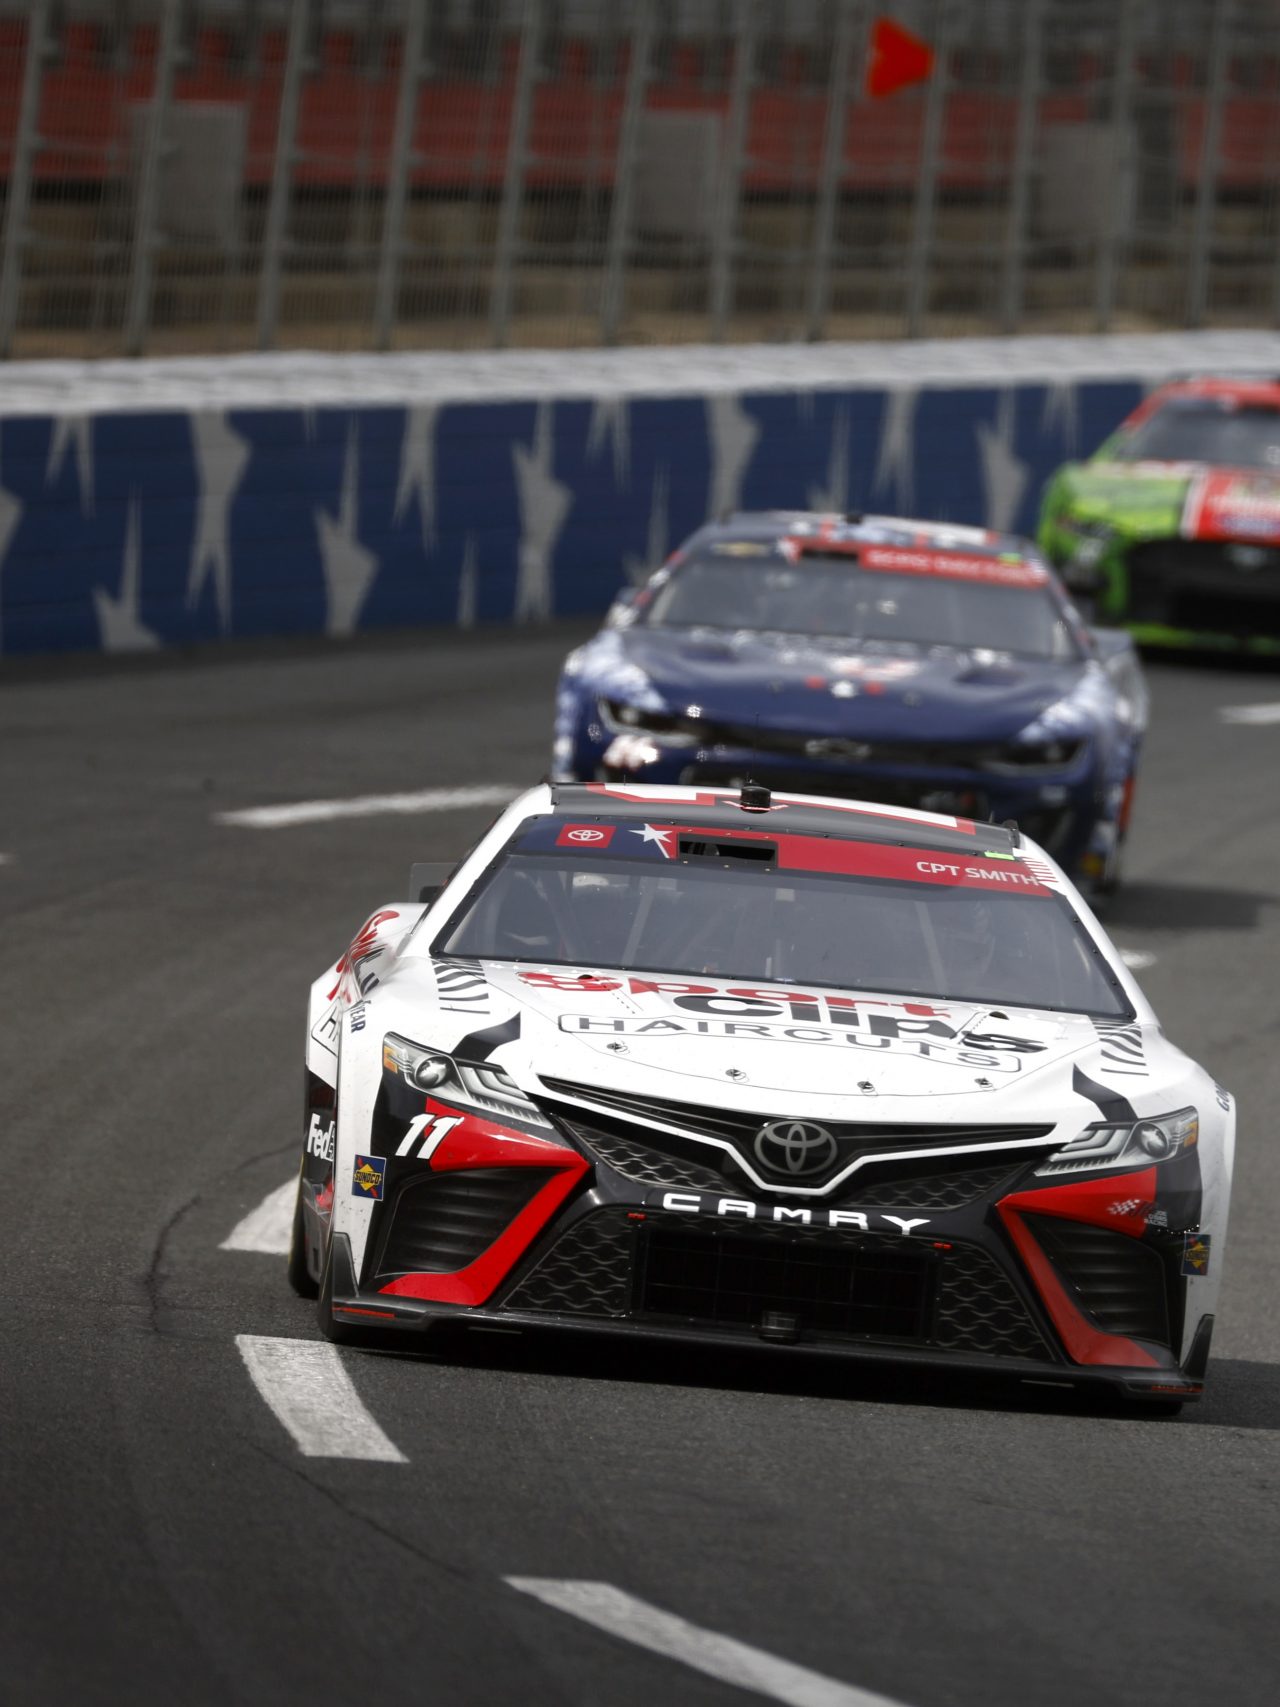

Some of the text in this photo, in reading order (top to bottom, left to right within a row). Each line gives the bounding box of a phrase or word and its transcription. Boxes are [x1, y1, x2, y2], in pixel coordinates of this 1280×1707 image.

[916, 861, 1040, 886] CPT SMITH
[577, 1015, 1003, 1068] HAIRCUTS
[395, 1113, 464, 1160] 11
[354, 1171, 381, 1185] SUNOCO
[662, 1192, 931, 1236] CAMRY
